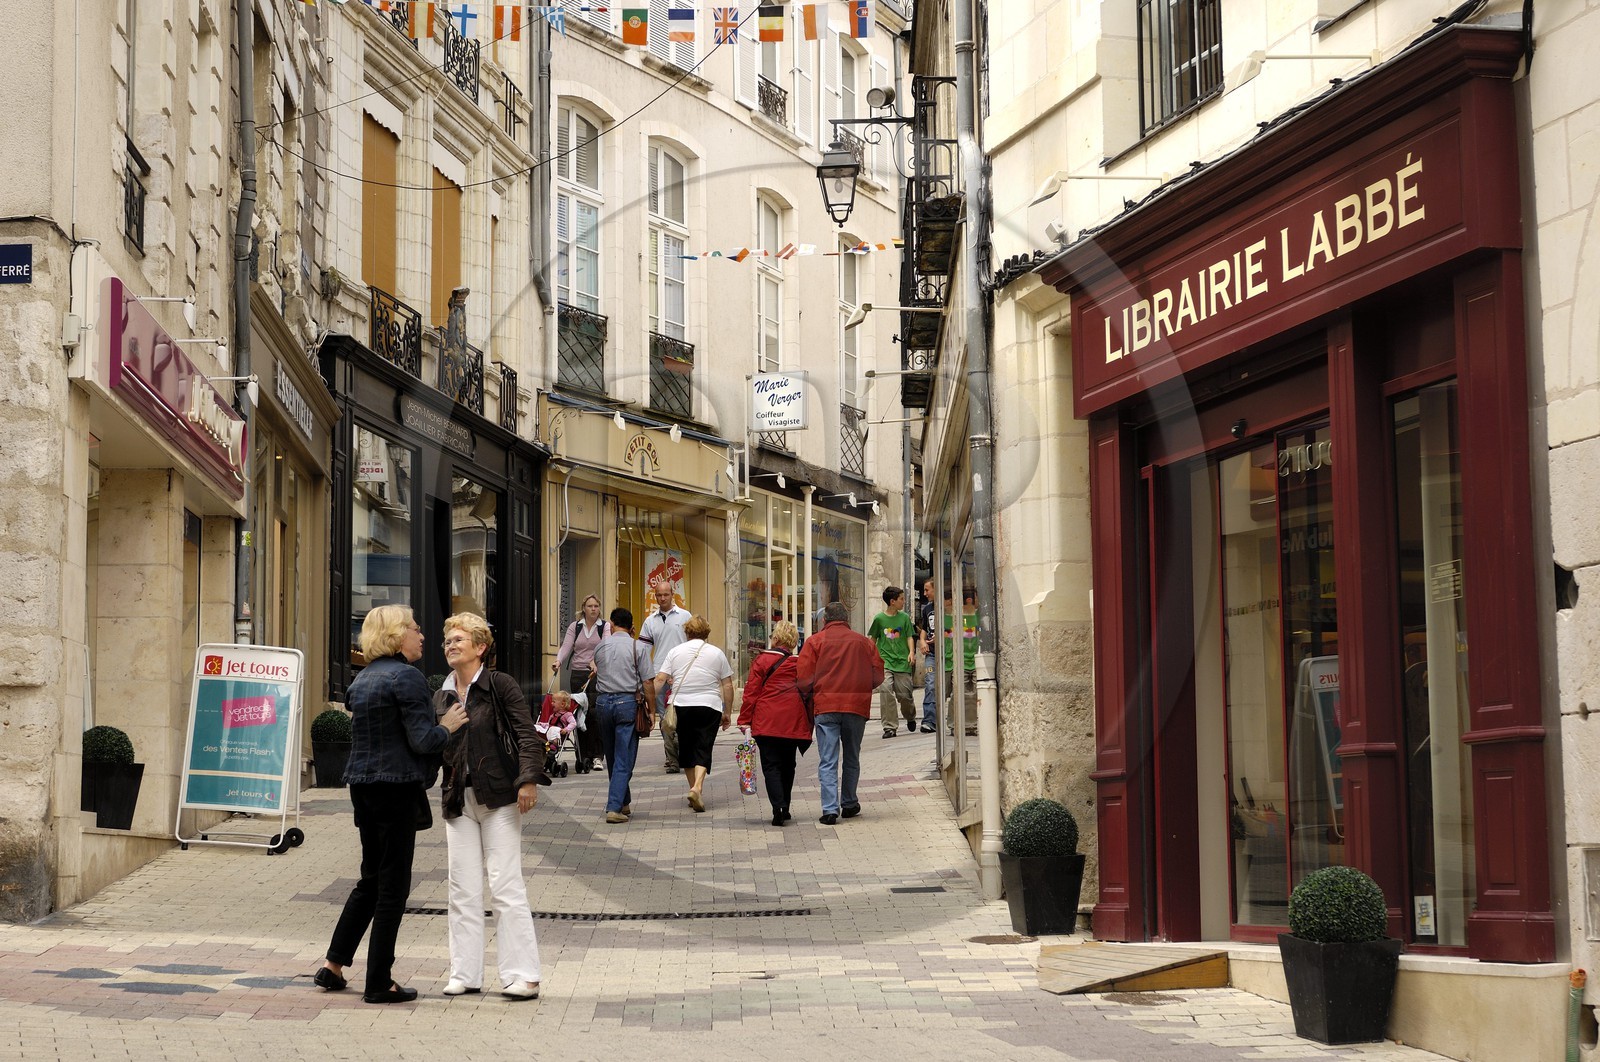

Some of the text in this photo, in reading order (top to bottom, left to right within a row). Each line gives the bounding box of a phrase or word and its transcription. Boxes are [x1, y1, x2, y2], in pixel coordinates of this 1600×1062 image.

[1104, 152, 1426, 364] LIBRAIRIE LABBÉ
[0, 264, 30, 277] ERRÉ
[754, 377, 789, 394] Marie
[767, 391, 802, 407] Verger
[755, 411, 785, 419] Coiffeur
[768, 418, 800, 427] Visagiste
[627, 436, 660, 467] PETIT BOY
[226, 660, 246, 676] Jet
[250, 661, 289, 677] tours
[202, 744, 218, 753] des
[219, 745, 248, 754] Ventes
[241, 790, 263, 798] tours
